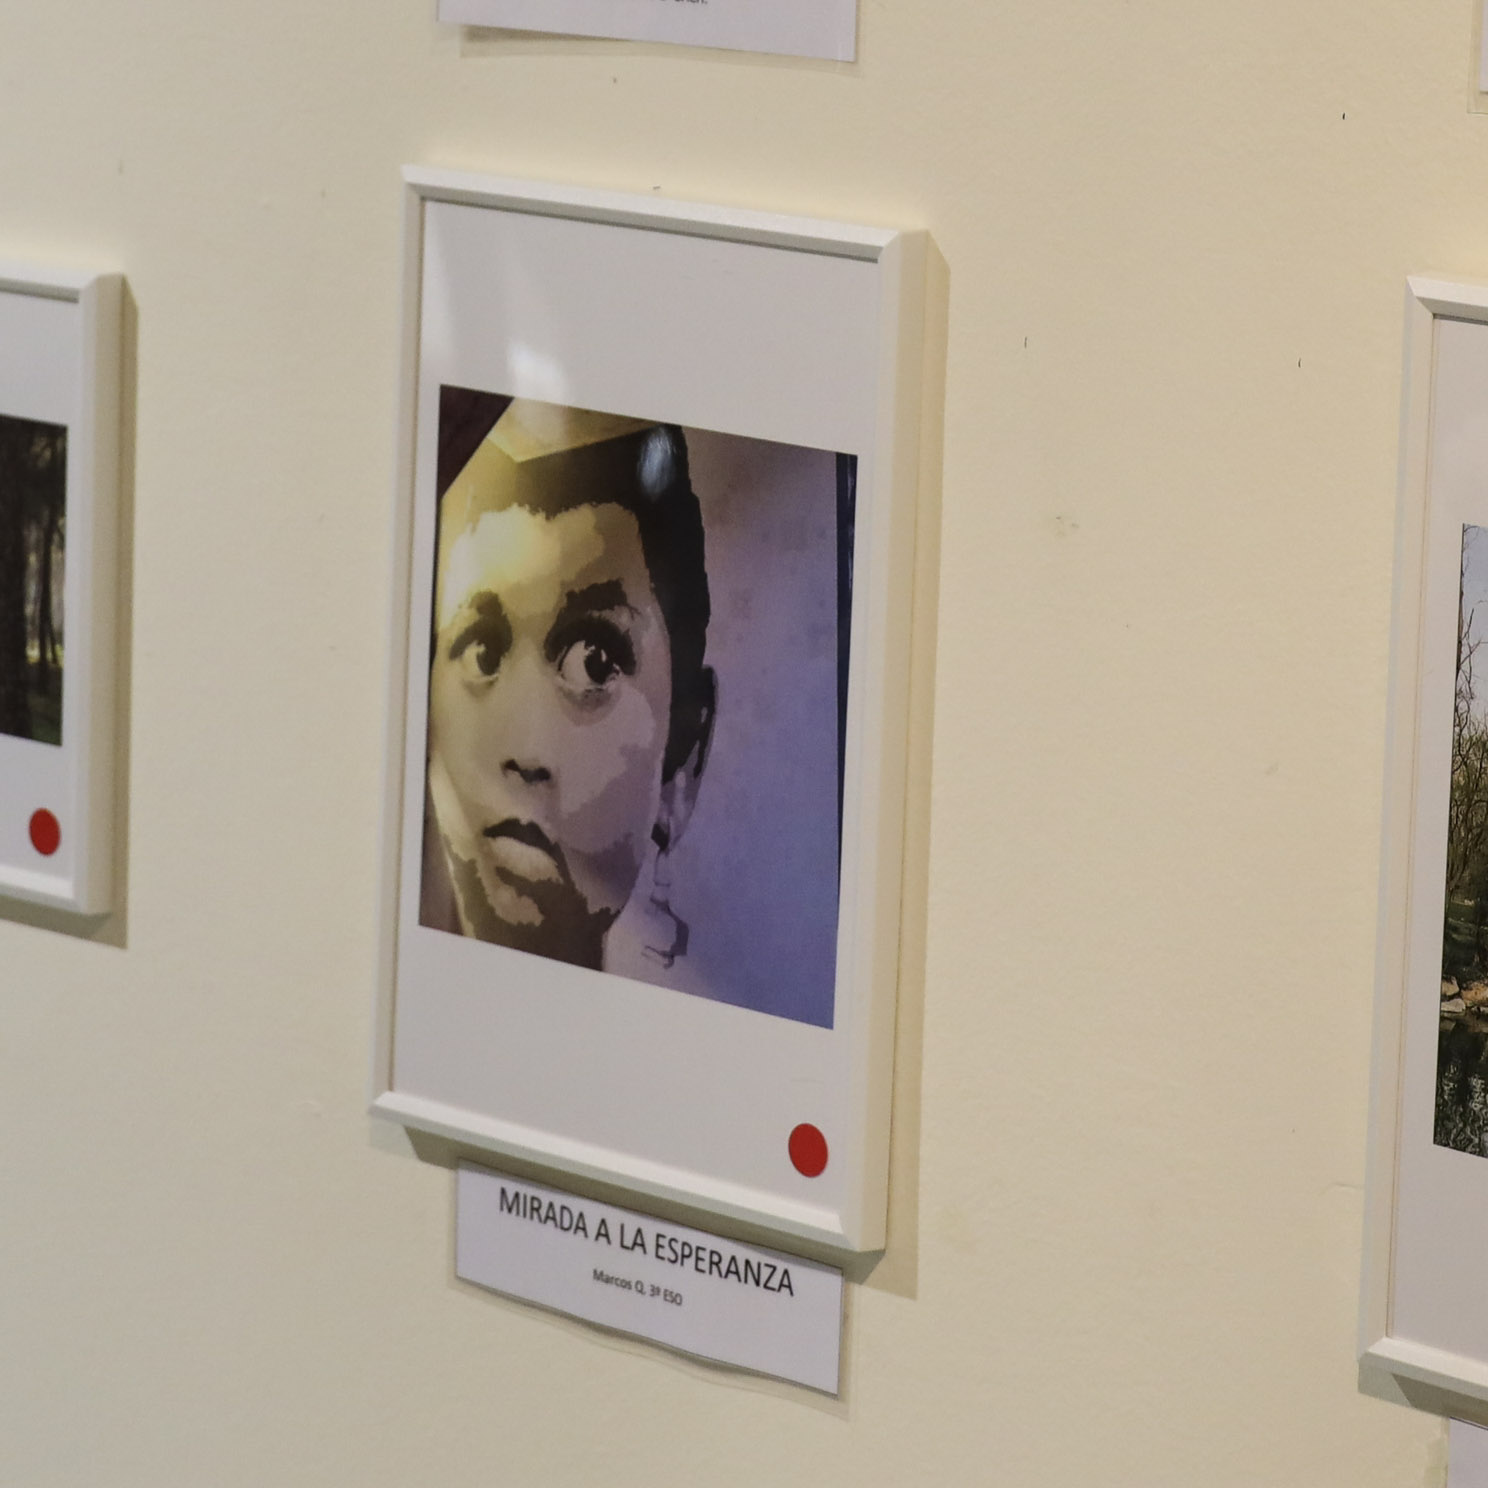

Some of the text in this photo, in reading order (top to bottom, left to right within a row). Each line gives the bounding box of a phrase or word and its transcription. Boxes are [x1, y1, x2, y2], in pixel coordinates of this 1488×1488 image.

[498, 1185, 795, 1298] MIRADA A LA ESPERANZA
[592, 1268, 633, 1291] Marcos
[662, 1287, 684, 1307] ESO
